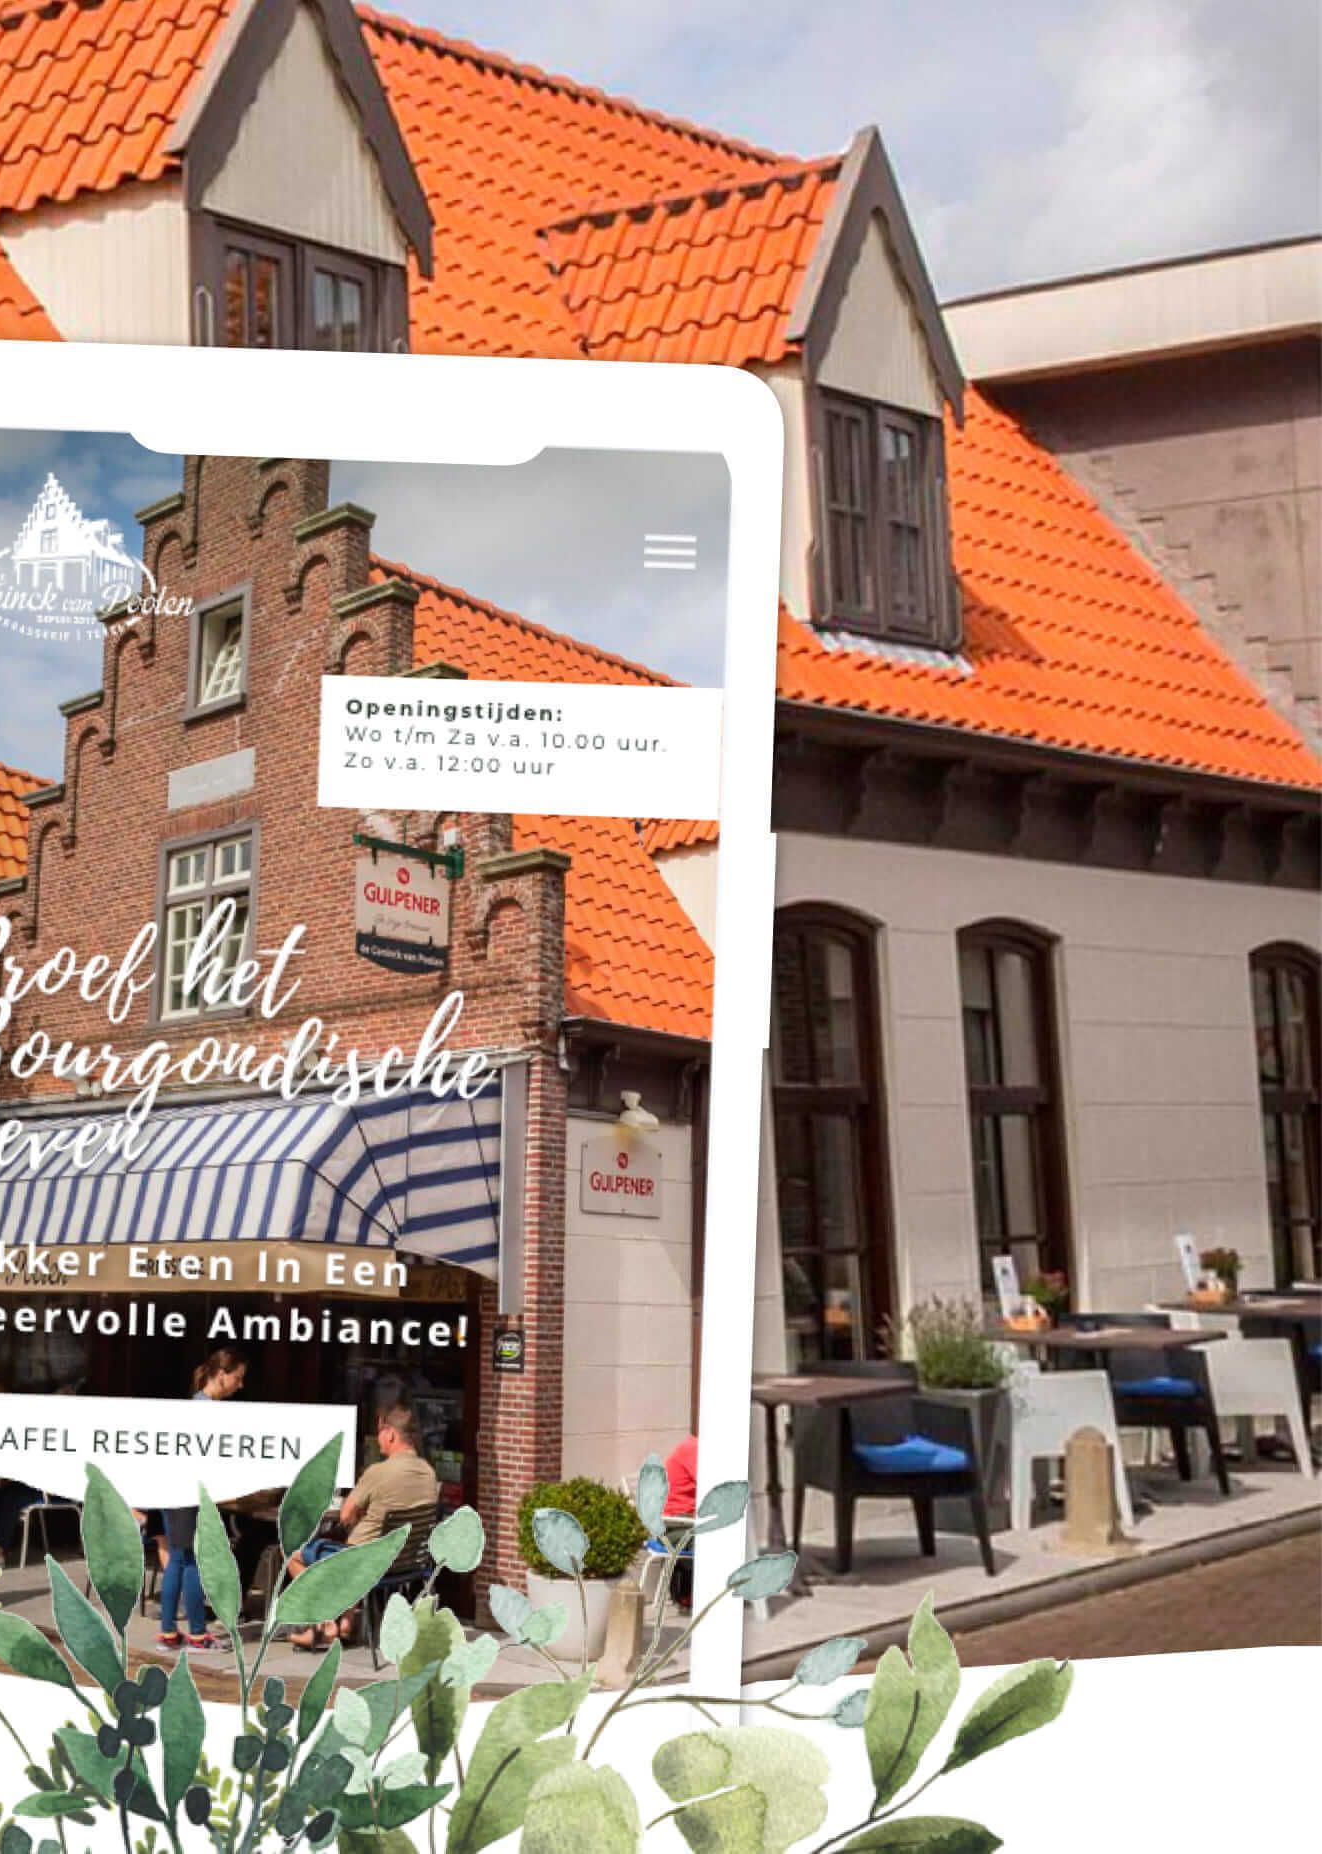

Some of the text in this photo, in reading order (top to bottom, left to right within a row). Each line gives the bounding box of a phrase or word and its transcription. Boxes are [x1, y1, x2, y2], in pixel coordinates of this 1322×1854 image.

[62, 598, 93, 613] van
[96, 582, 196, 617] Poolen
[345, 698, 563, 723] Openingstijden:
[344, 725, 669, 753] Wo t/m Za v.a. 10.00 uur.
[343, 752, 556, 776] Zo v.a. 12:00 uur
[363, 882, 441, 916] GULPENER
[182, 897, 308, 1019] het
[590, 1171, 654, 1197] GULPENER
[128, 1246, 234, 1281] Eten
[258, 1250, 302, 1285] In
[324, 1252, 409, 1288] Een
[207, 1305, 470, 1349] Ambiance!
[92, 1430, 302, 1461] RESERVEREN
